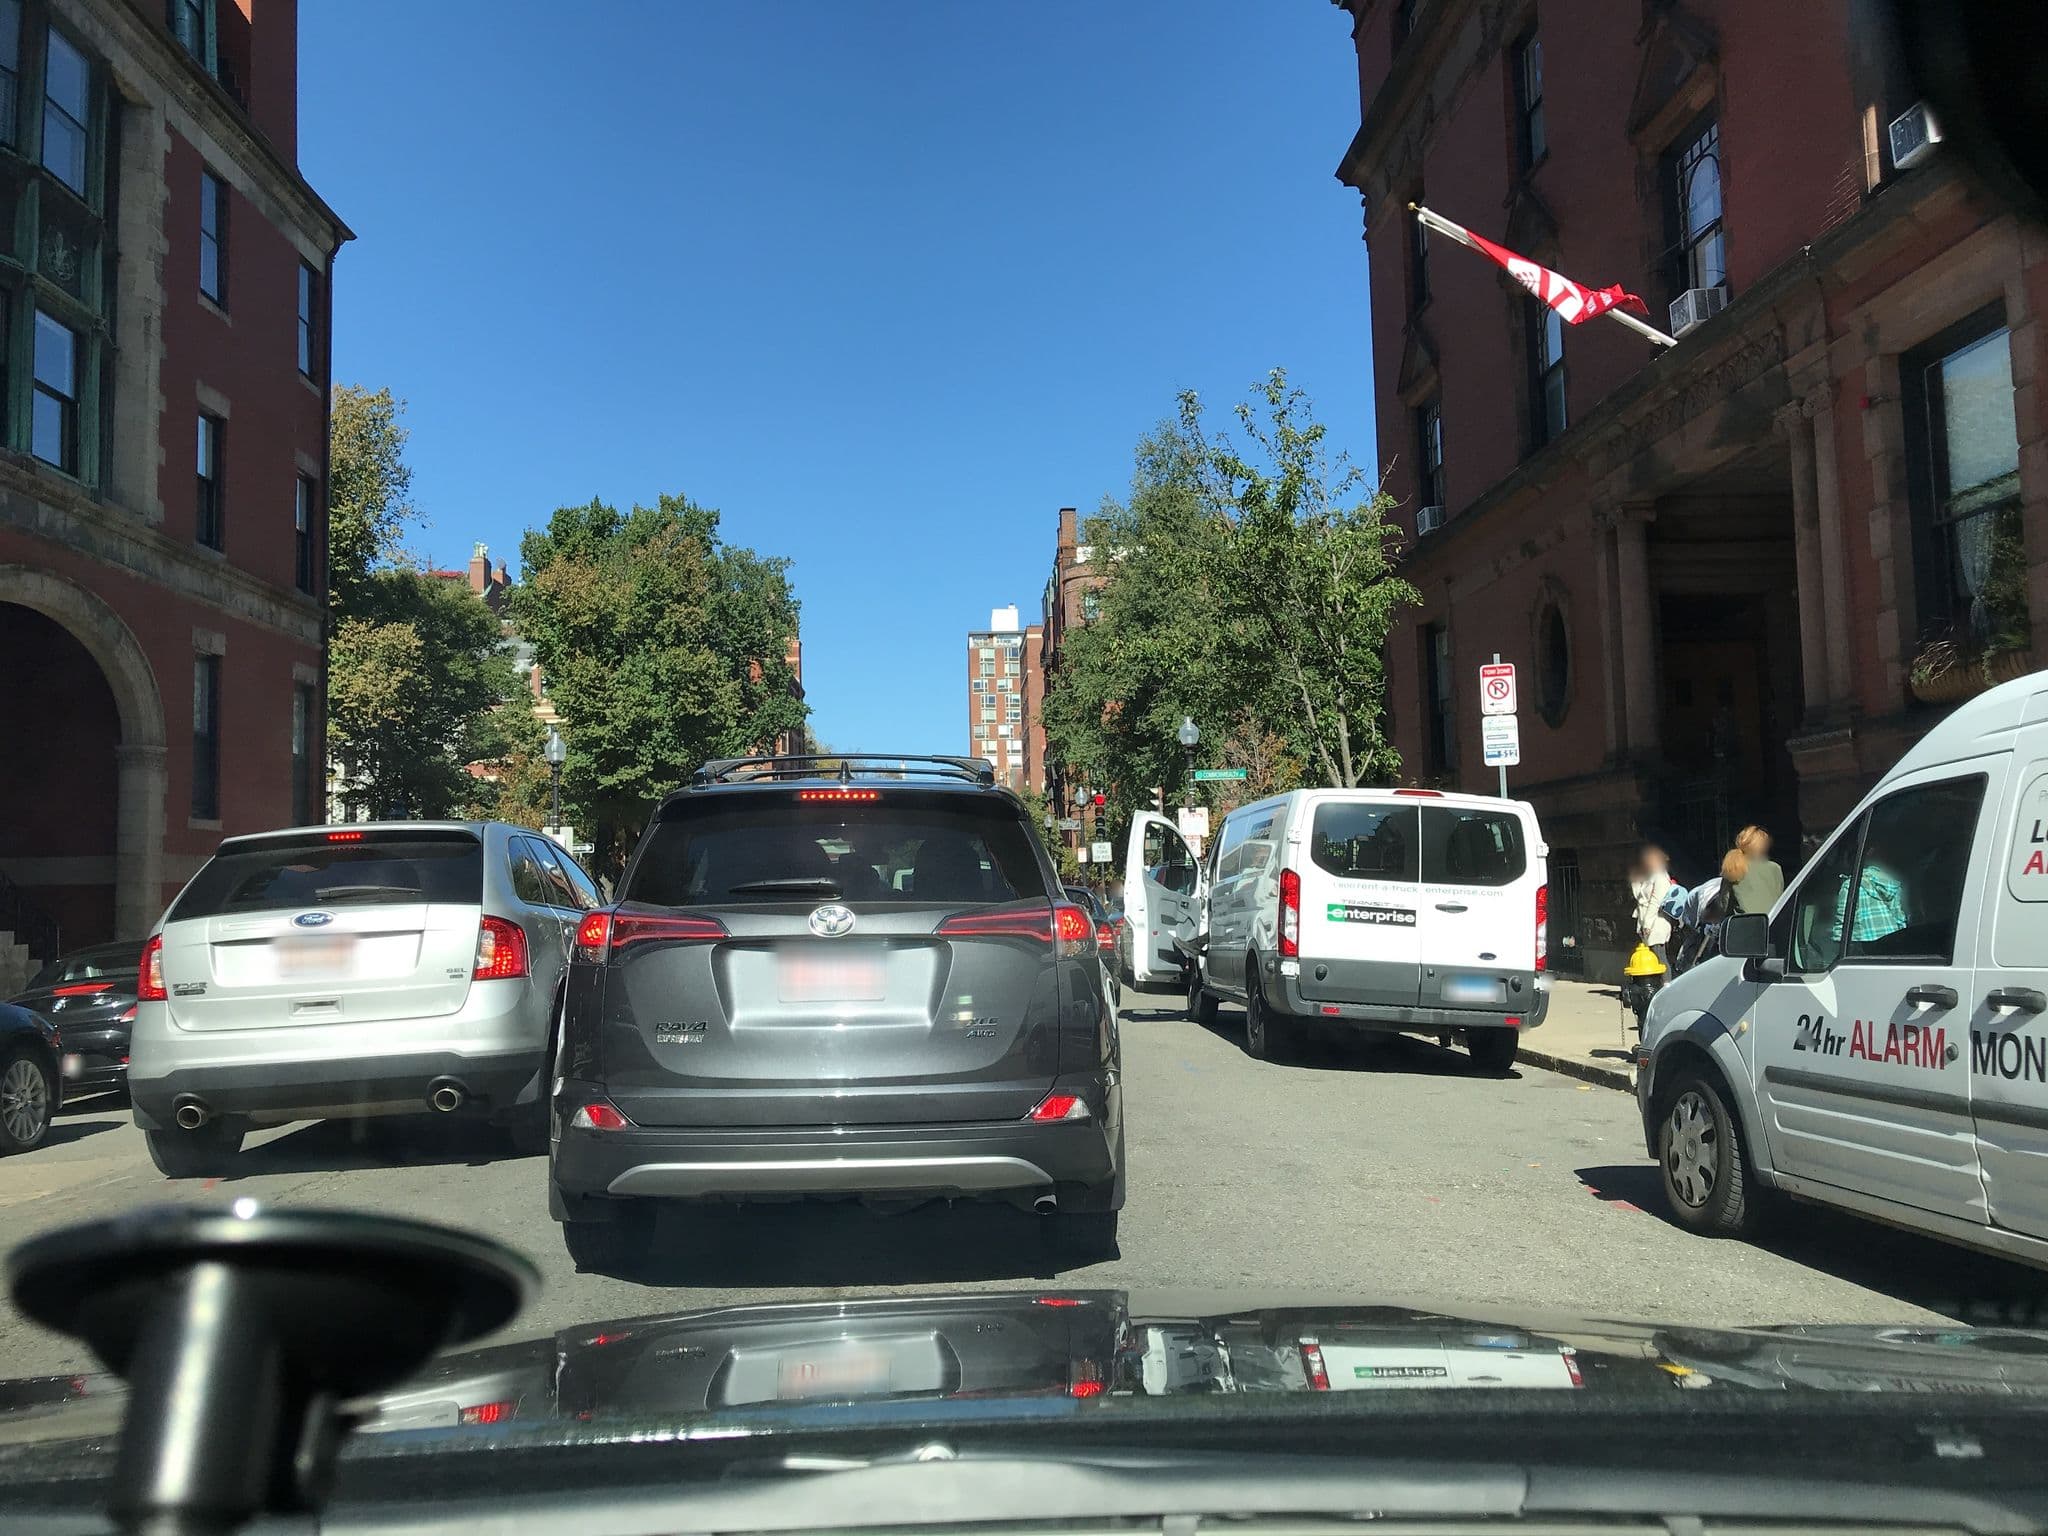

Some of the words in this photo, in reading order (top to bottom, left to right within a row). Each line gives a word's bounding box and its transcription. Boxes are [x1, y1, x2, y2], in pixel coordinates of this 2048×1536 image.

[1330, 907, 1416, 924] enterprise
[656, 1021, 708, 1031] RAV4
[1849, 1020, 1946, 1070] ALARM
